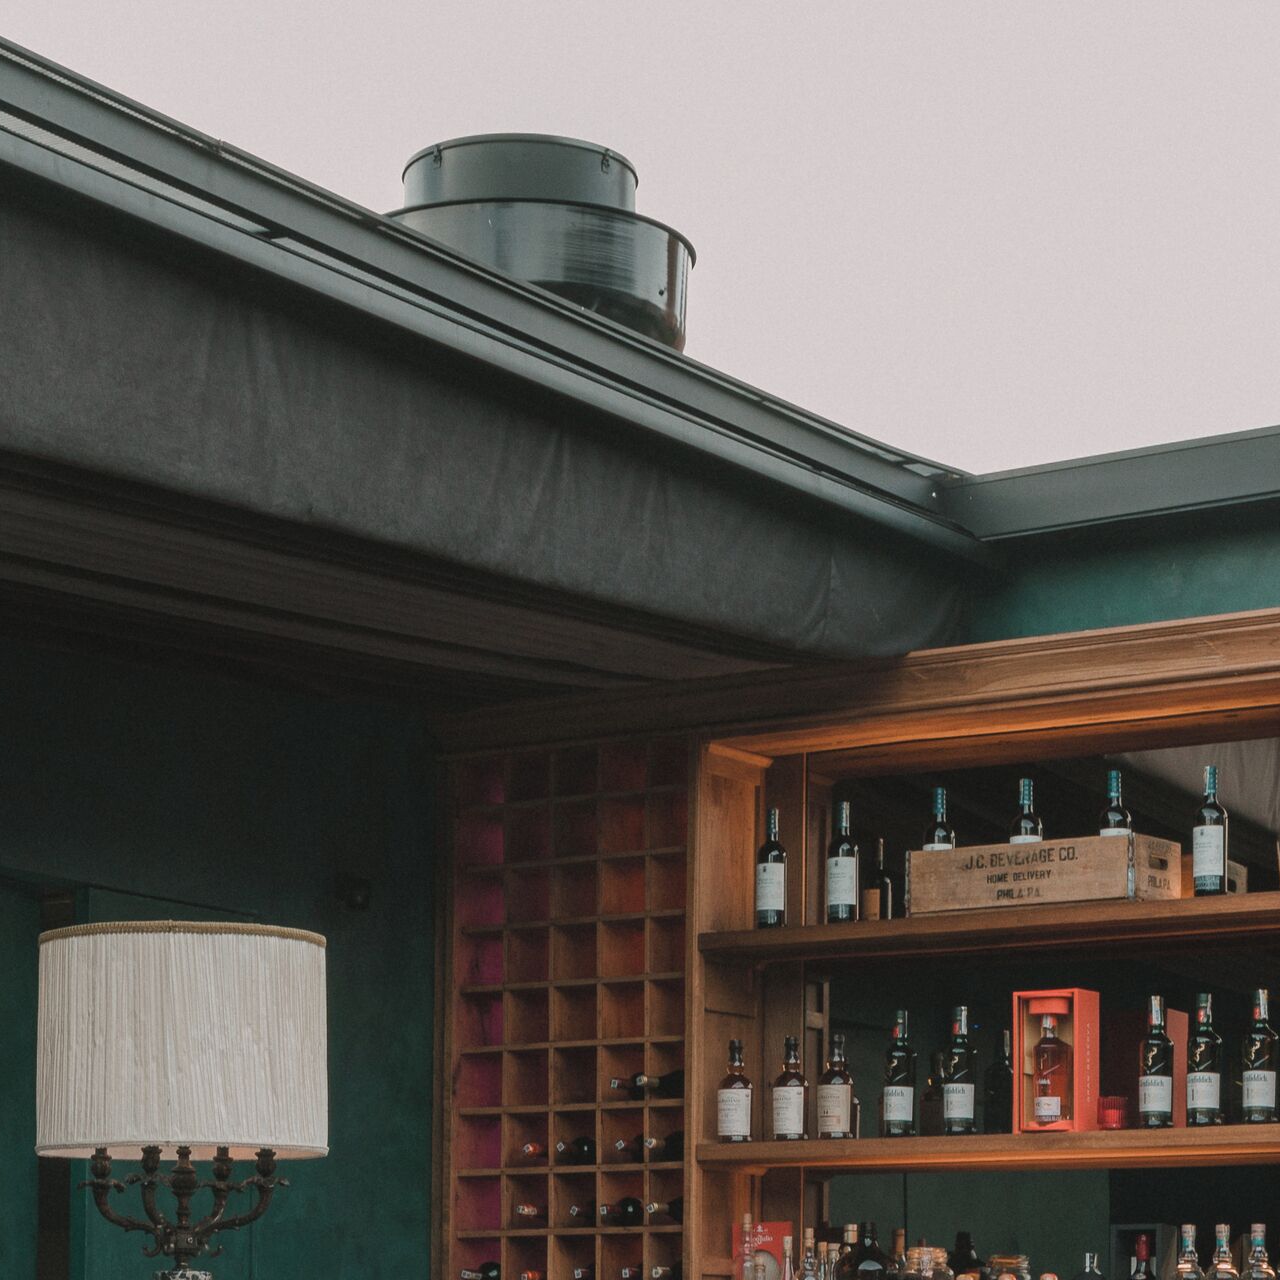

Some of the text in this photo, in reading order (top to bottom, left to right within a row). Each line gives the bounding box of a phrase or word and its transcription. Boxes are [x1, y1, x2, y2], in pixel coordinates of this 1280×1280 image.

[966, 846, 1079, 870] J.C. BEVERAGE CO.
[986, 870, 1052, 885] HOME DELIVERY
